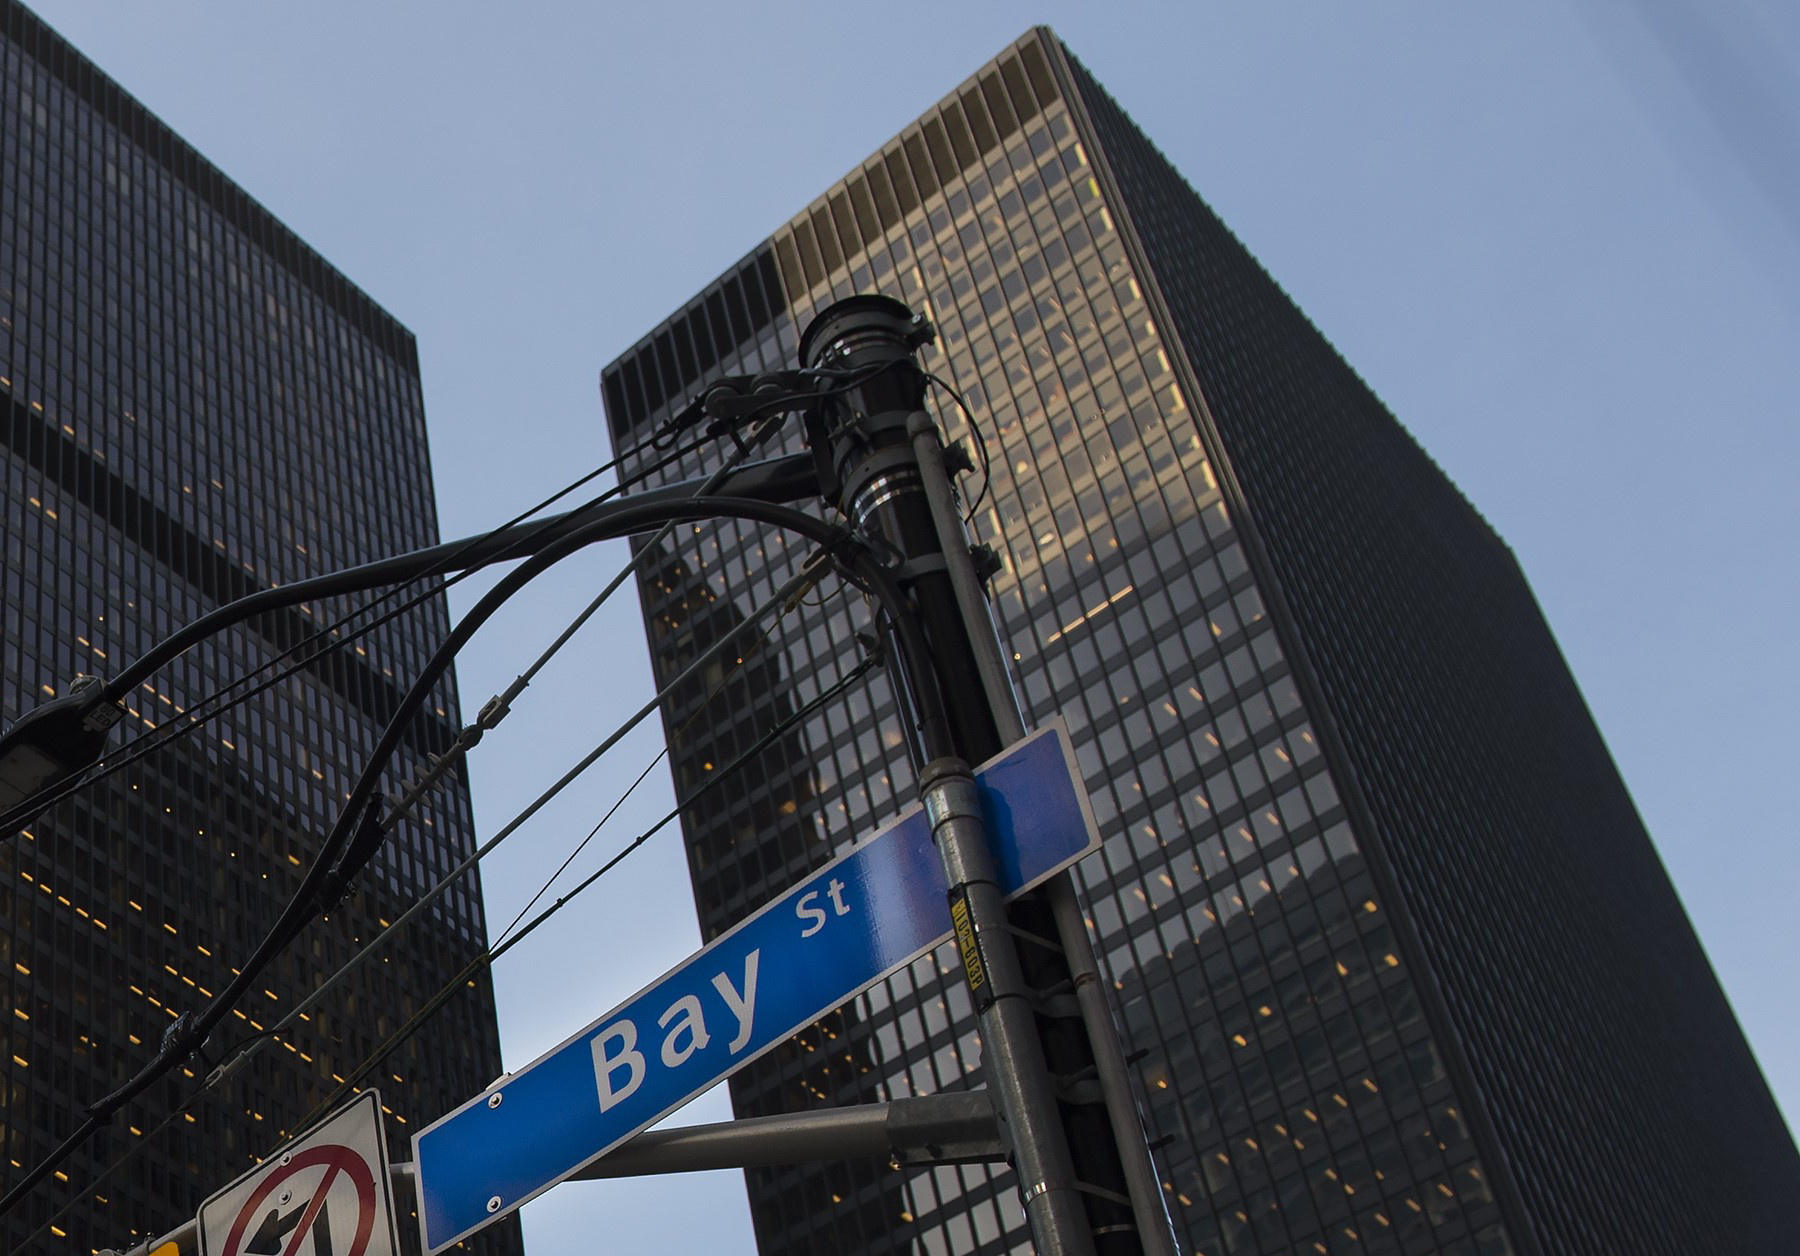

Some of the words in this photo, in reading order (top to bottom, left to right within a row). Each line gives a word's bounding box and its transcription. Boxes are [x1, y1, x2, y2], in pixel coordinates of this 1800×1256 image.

[89, 710, 112, 727] LED
[589, 947, 760, 1114] Bay
[795, 877, 851, 938] St
